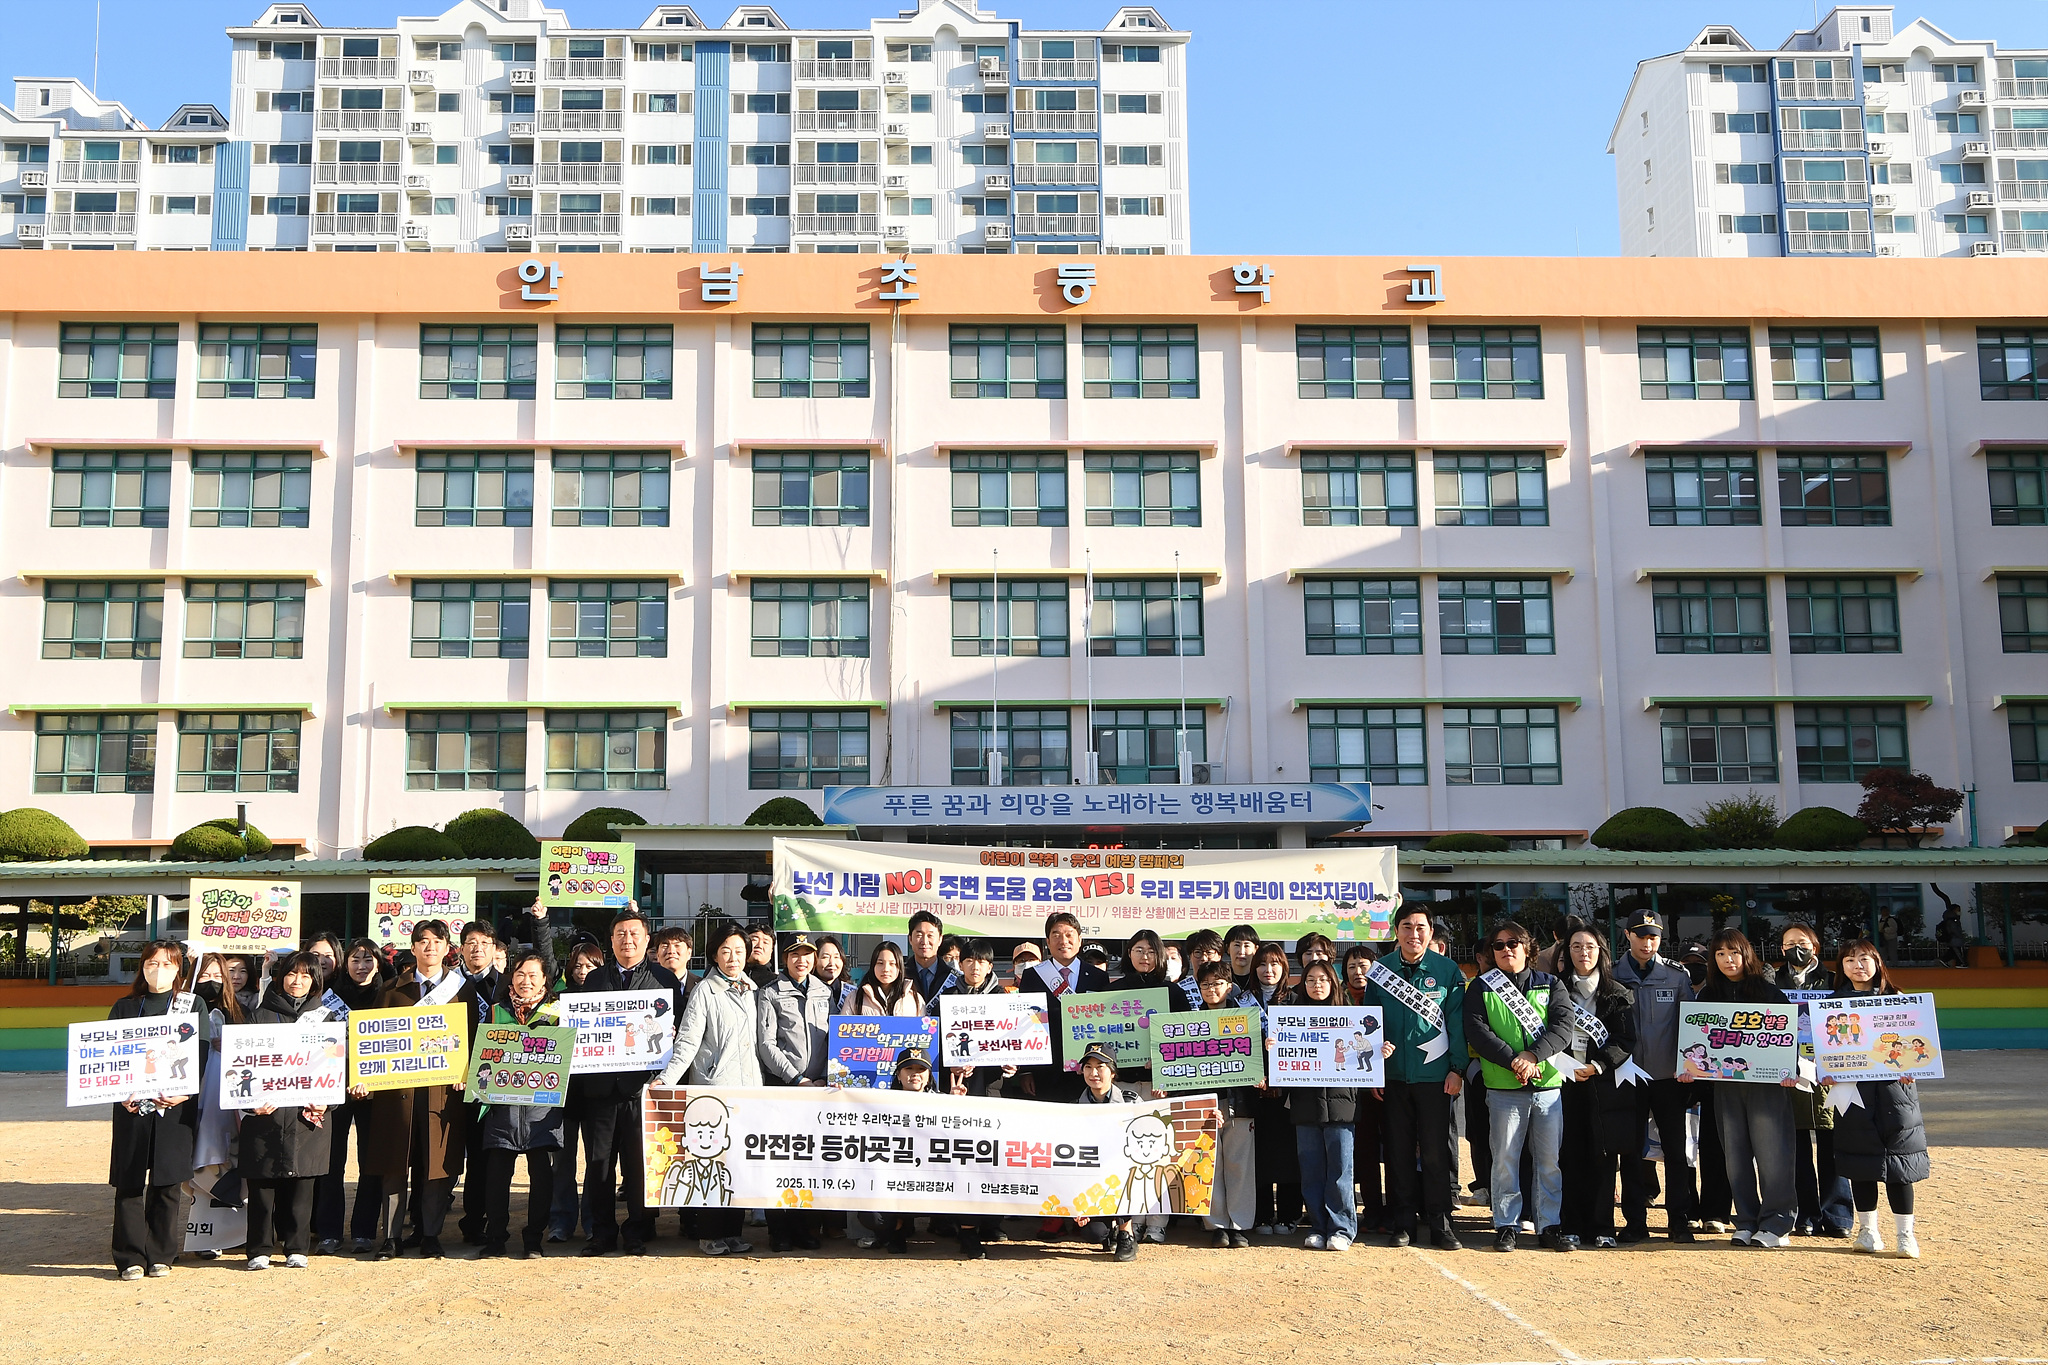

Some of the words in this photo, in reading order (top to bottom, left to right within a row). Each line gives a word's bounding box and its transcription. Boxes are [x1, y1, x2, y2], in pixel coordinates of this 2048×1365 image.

[883, 794, 933, 817] 푸른
[941, 793, 991, 817] 꿈과
[999, 793, 1074, 816] 희망을
[1082, 792, 1181, 816] 노래하는
[1190, 791, 1312, 815] 행복배움터
[586, 852, 618, 865] 안전한
[979, 850, 1025, 867] 어린이
[1028, 852, 1058, 868] 약취
[1070, 853, 1100, 868] 유인
[1105, 854, 1136, 868] 예방
[1139, 854, 1184, 869] 캠페인
[548, 861, 578, 874] 세상을
[579, 864, 624, 874] 만들어주세요
[793, 870, 834, 897] 낯선
[839, 872, 880, 898] 사람
[885, 868, 932, 896] NO!
[938, 875, 979, 900] 주변
[985, 876, 1026, 901] 도움
[1032, 877, 1073, 901] 요청
[1075, 872, 1134, 899] YES!
[1140, 880, 1173, 899] 우리
[1178, 880, 1229, 899] 모두가
[1234, 881, 1284, 900] 어린이
[1289, 881, 1374, 900] 안전지킴이
[202, 889, 252, 909] 괜찮아
[421, 889, 460, 904] 안전한
[202, 908, 217, 925] 넌
[217, 910, 250, 923] 이겨낼
[252, 908, 263, 921] 수
[265, 909, 287, 922] 있어
[375, 902, 411, 916] 세상을
[413, 904, 469, 916] 만들어주세요
[856, 902, 876, 913] 낯선
[879, 902, 900, 914] 사람
[902, 903, 943, 915] 따라가지
[946, 903, 966, 915] 않기
[978, 904, 1008, 917] 사람이
[1012, 905, 1032, 917] 많은
[1069, 906, 1099, 918] 다니기
[1112, 906, 1142, 919] 위험한
[1145, 907, 1185, 919] 상황에선
[1189, 907, 1230, 919] 큰소리로
[1233, 908, 1254, 920] 도움
[1257, 908, 1298, 920] 요청하기
[201, 925, 225, 936] 내가
[227, 925, 249, 938] 옆에
[250, 926, 292, 939] 있어줄게
[568, 1001, 601, 1013] 부모님
[950, 1005, 986, 1015] 등하교길
[1067, 1003, 1106, 1019] 안전한
[1109, 999, 1144, 1017] 스쿨존
[1818, 1001, 1843, 1010] 지켜요
[1850, 998, 1882, 1009] 등하교길
[358, 1018, 411, 1034] 아이들의
[417, 1015, 447, 1030] 안전,
[568, 1017, 590, 1028] 아는
[594, 1016, 626, 1027] 사람도
[951, 1020, 995, 1031] 스마트폰
[1277, 1016, 1306, 1027] 부모님
[1309, 1016, 1349, 1027] 동의없이
[1685, 1012, 1728, 1028] 어린이는
[80, 1030, 118, 1042] 부모님
[838, 1023, 880, 1038] 안전한
[877, 1033, 933, 1049] 학교생활
[1071, 1023, 1097, 1040] 밝은
[1098, 1022, 1135, 1035] 미래의
[1162, 1024, 1185, 1038] 학교
[1187, 1021, 1211, 1037] 앞은
[1277, 1032, 1297, 1042] 아는
[1300, 1032, 1330, 1042] 사람도
[234, 1037, 275, 1049] 등하교길
[486, 1029, 529, 1044] 어린이가
[522, 1037, 556, 1053] 안전한
[978, 1039, 1023, 1051] 낯선사람
[1708, 1028, 1755, 1049] 권리가
[1757, 1032, 1794, 1048] 있어요
[80, 1047, 104, 1059] 아는
[109, 1043, 147, 1056] 사람도
[358, 1038, 411, 1055] 온마을이
[582, 1046, 604, 1057] 돼요
[1108, 1040, 1140, 1053] 입니다
[1159, 1037, 1252, 1061] 절대보호구역
[1277, 1047, 1318, 1058] 따라가면
[232, 1053, 284, 1067] 스마트폰
[480, 1048, 511, 1063] 세상을
[513, 1052, 562, 1064] 만들어주세요
[839, 1047, 895, 1062] 우리함께
[79, 1060, 130, 1075] 따라가면
[359, 1061, 386, 1075] 함께
[391, 1055, 448, 1071] 지킵니다.
[1161, 1064, 1196, 1078] 예외는
[1199, 1060, 1245, 1077] 없습니다
[1278, 1060, 1288, 1071] 안
[1291, 1060, 1311, 1071] 돼요
[79, 1077, 92, 1088] 안
[95, 1074, 120, 1087] 돼요
[262, 1075, 313, 1091] 낯선사람
[826, 1112, 858, 1126] 안전한
[862, 1113, 911, 1127] 우리학교를
[915, 1114, 937, 1128] 함께
[941, 1116, 992, 1129] 만들어가요
[744, 1133, 815, 1160] 안전한
[820, 1135, 921, 1167] 등하굣길,
[928, 1138, 999, 1167] 모두의
[1005, 1140, 1101, 1168] 관심으로
[887, 1180, 954, 1192] 부산동래경찰서
[980, 1183, 1039, 1195] 안남초등학교
